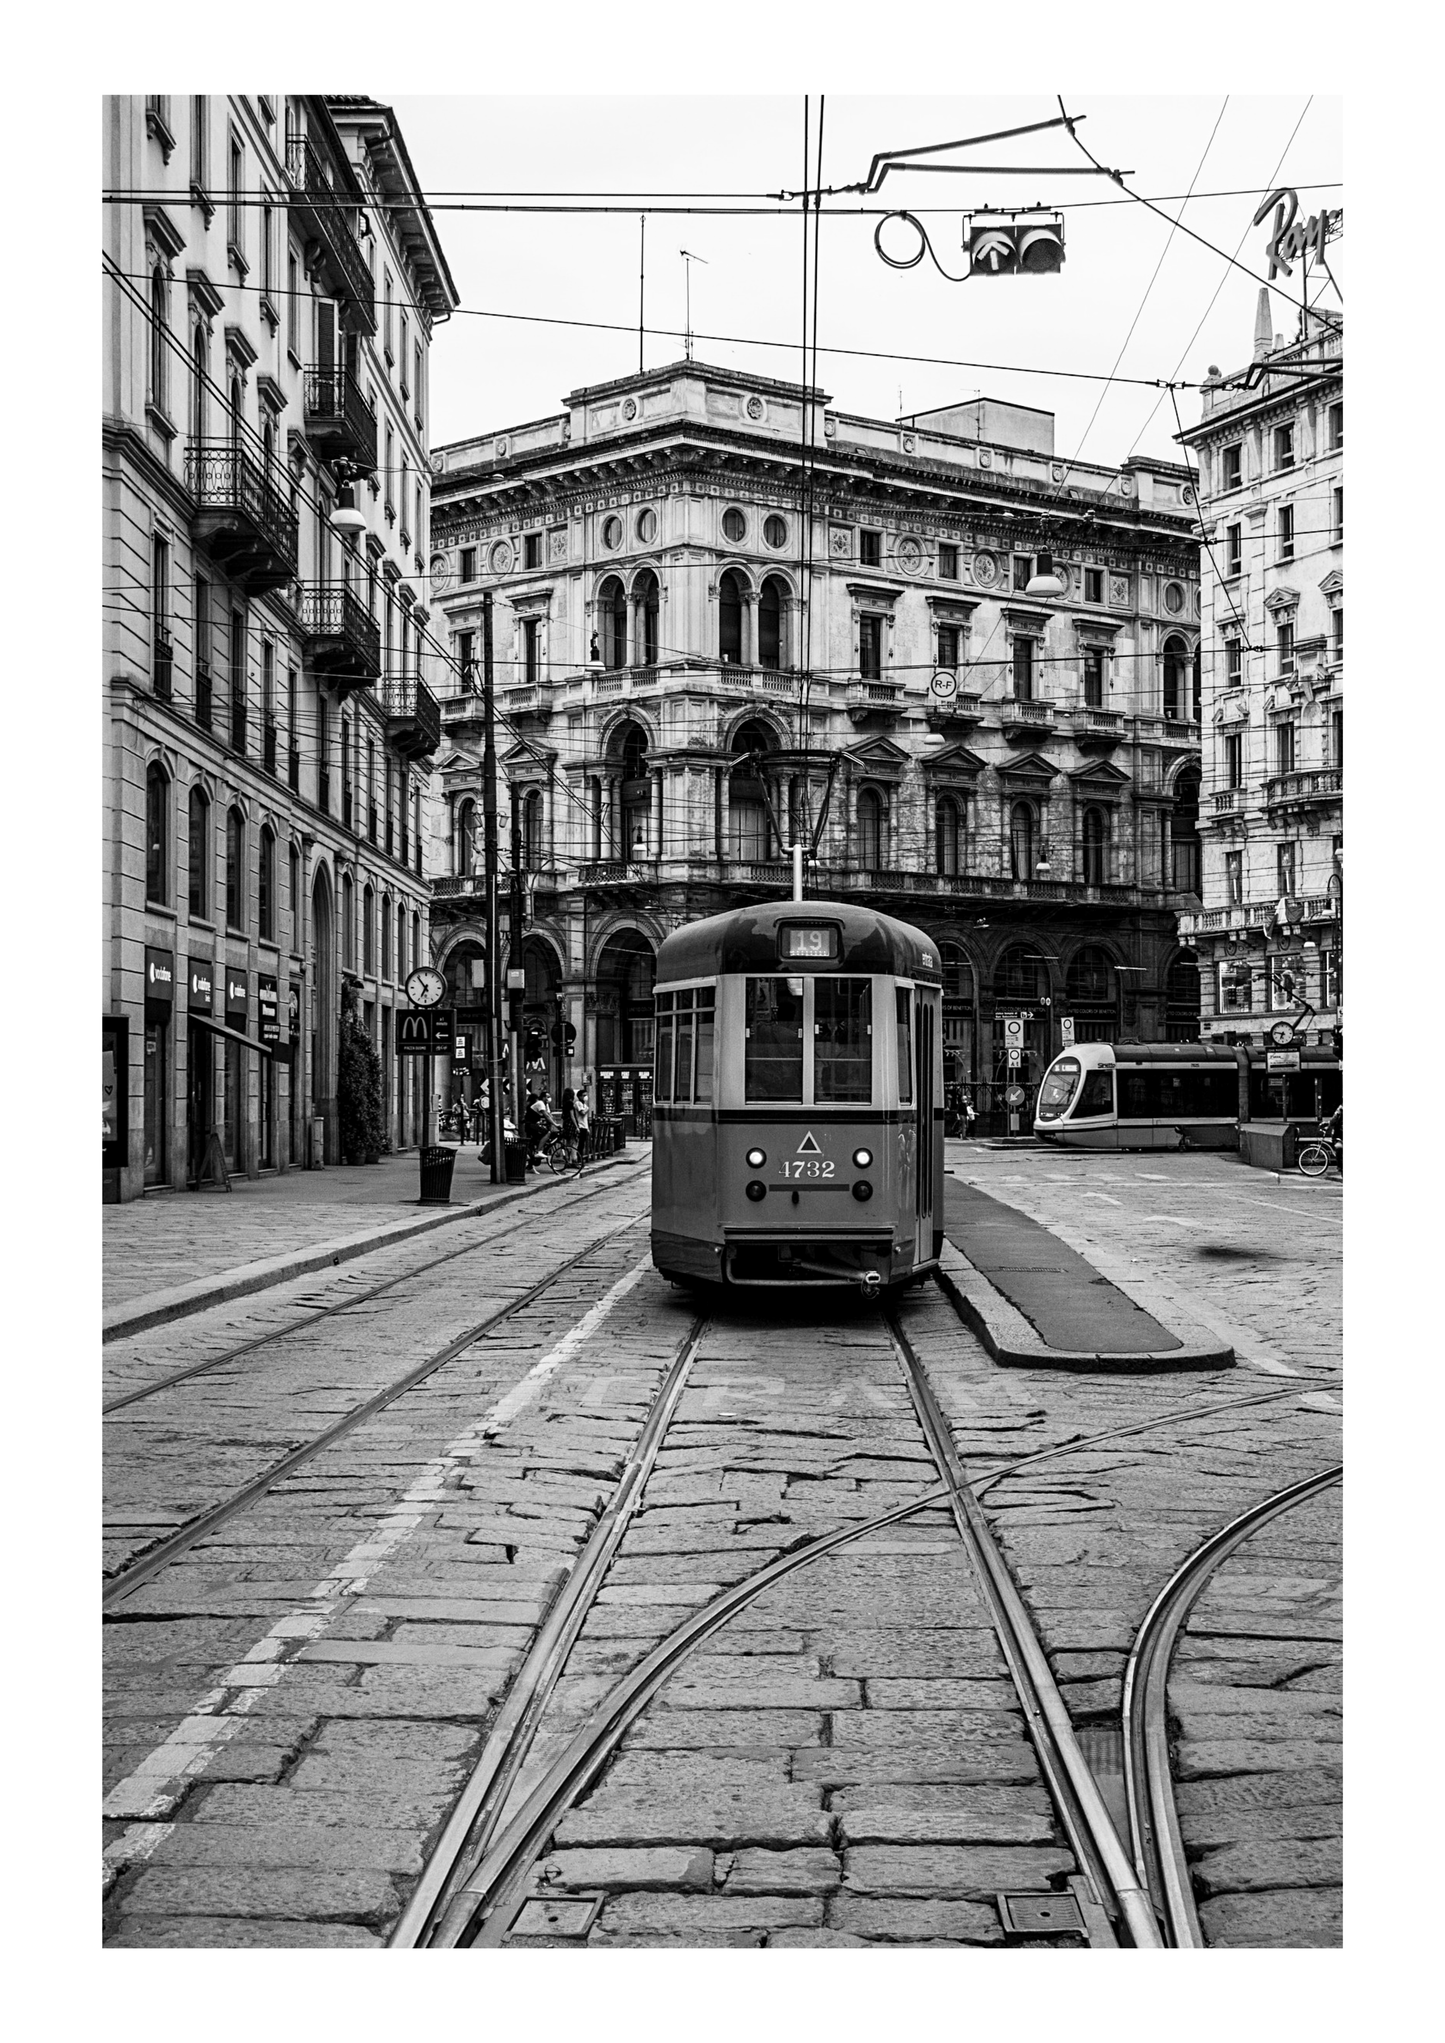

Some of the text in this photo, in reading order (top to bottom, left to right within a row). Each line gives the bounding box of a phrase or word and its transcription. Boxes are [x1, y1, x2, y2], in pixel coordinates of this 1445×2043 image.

[935, 680, 952, 689] R-F
[797, 930, 822, 951] 19
[778, 1160, 835, 1178] 4732
